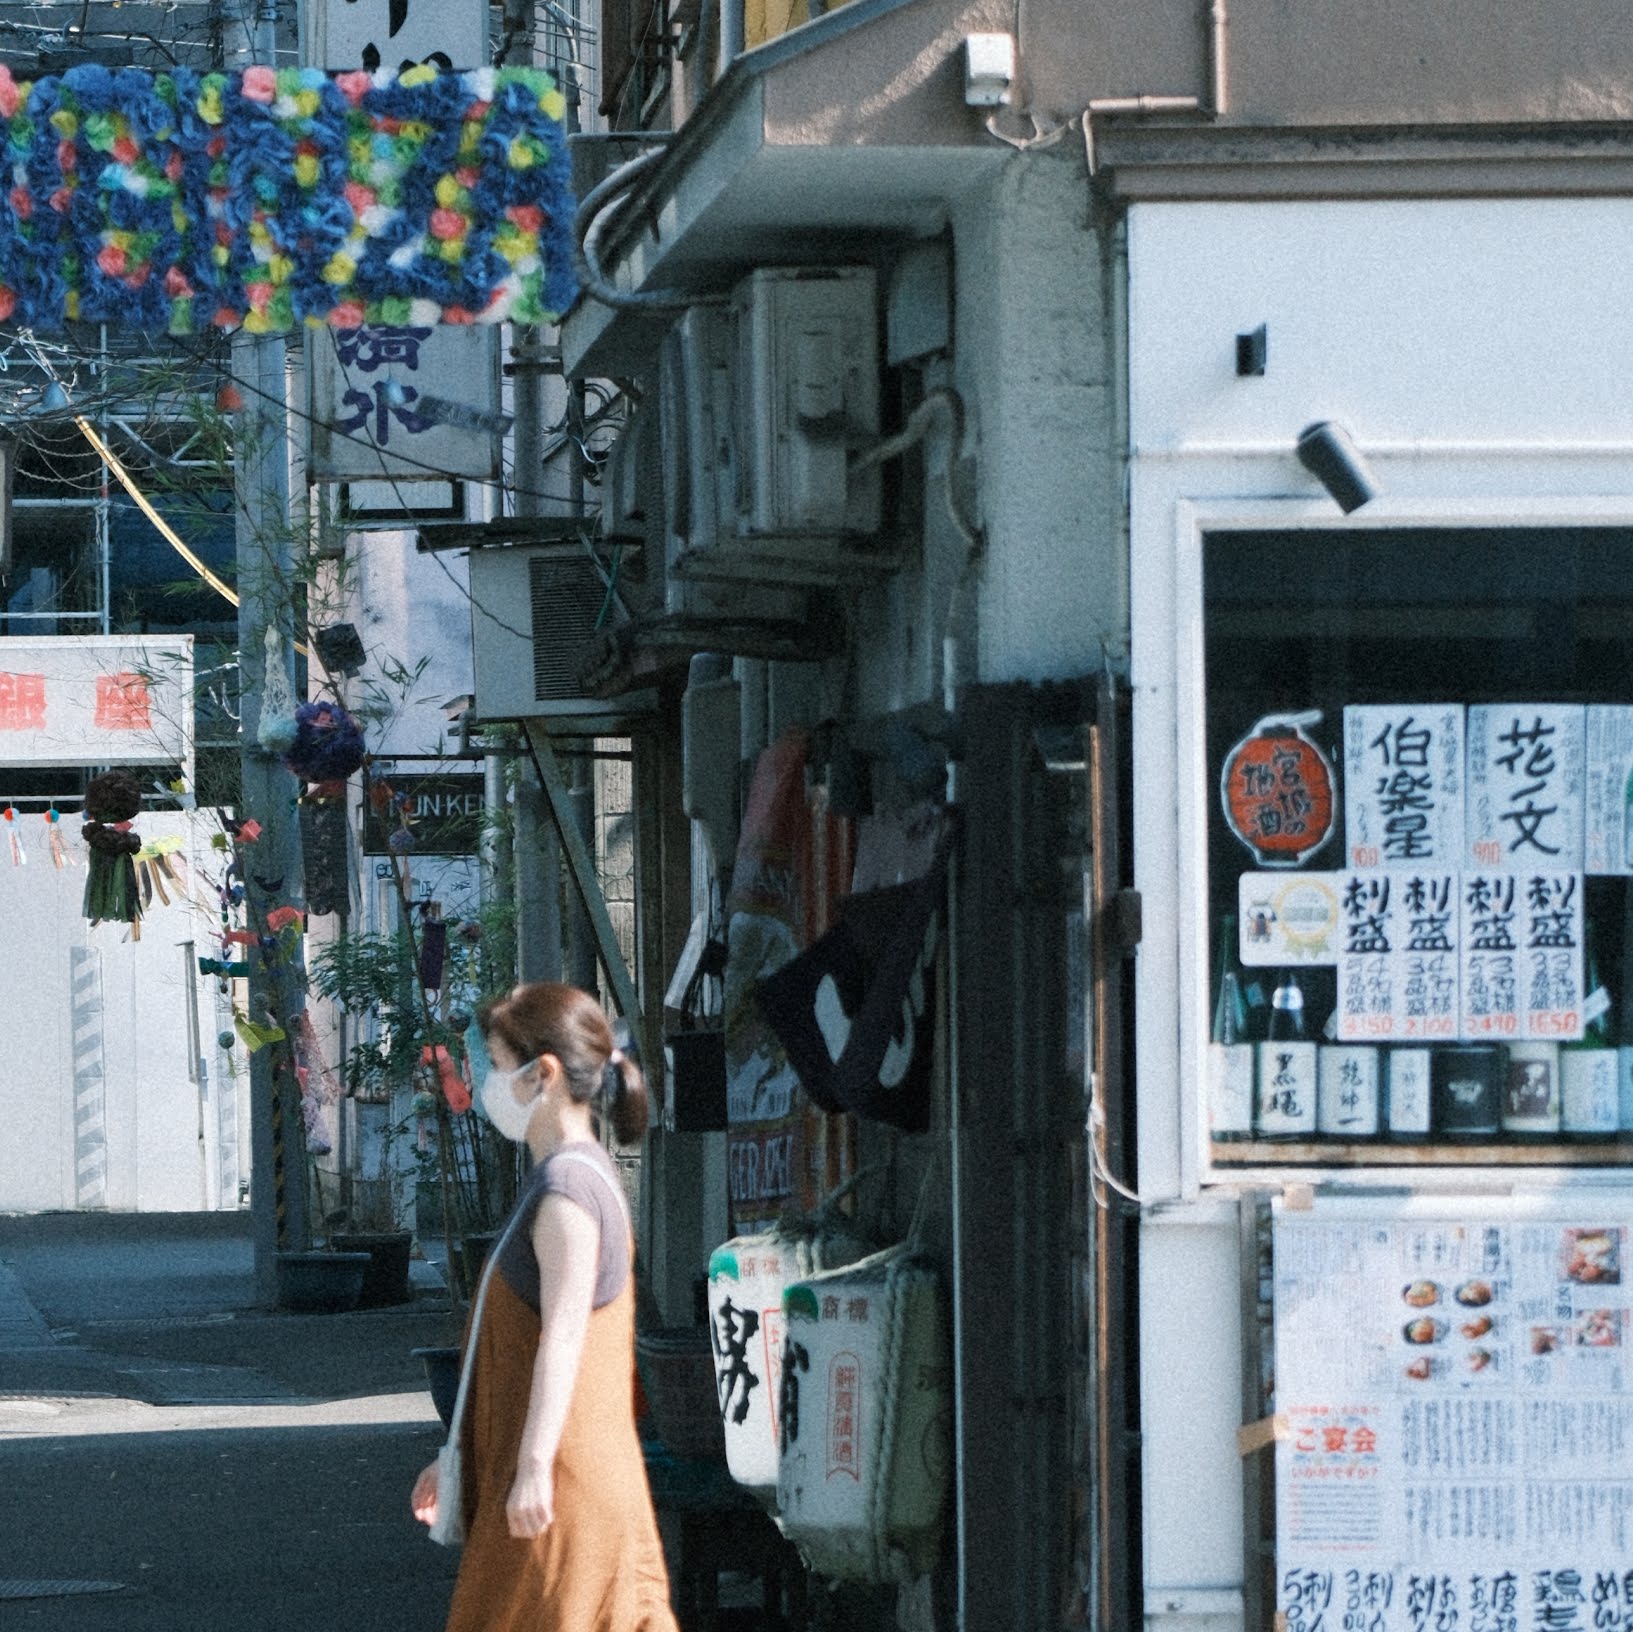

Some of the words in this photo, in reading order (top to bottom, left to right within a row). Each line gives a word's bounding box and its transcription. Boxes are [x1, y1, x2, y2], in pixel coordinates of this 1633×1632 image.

[1370, 717, 1436, 860] 伯楽星
[1343, 876, 1393, 954] 刺盛
[1405, 876, 1456, 952] 刺盛
[1466, 875, 1517, 951] 刺盛
[1526, 875, 1577, 949] 刺盛
